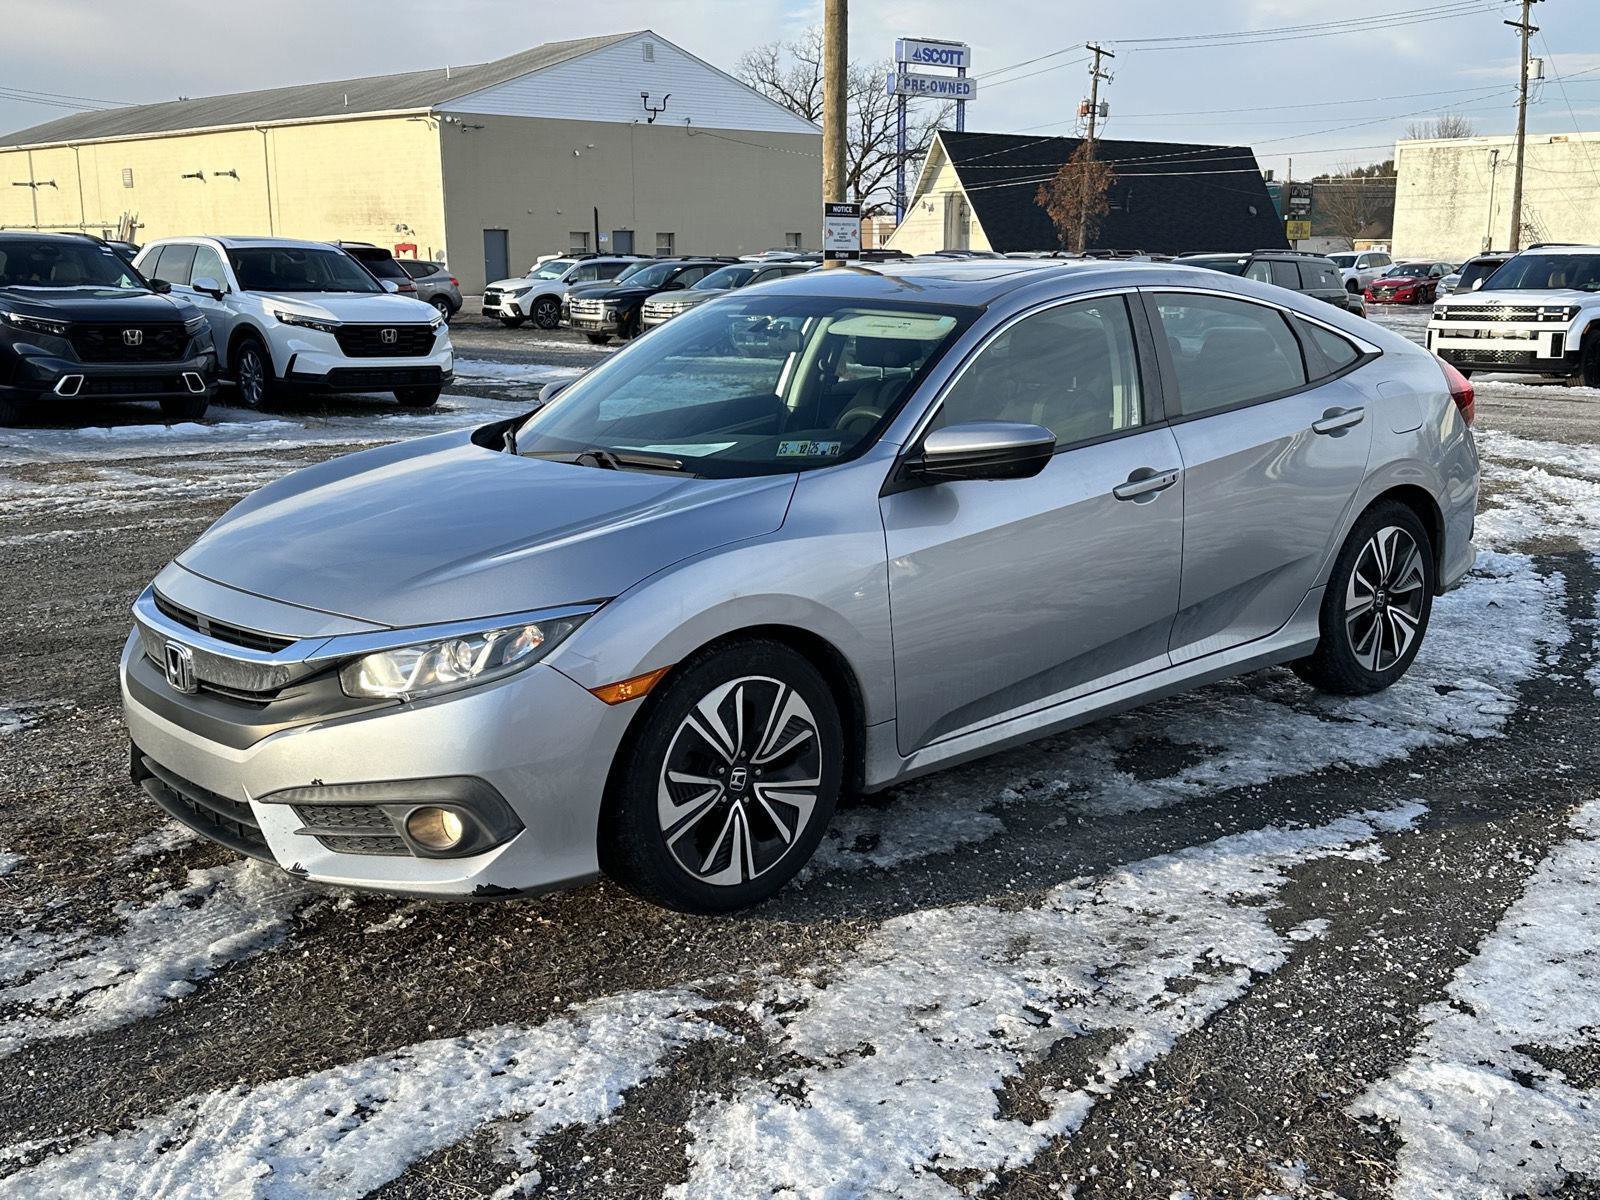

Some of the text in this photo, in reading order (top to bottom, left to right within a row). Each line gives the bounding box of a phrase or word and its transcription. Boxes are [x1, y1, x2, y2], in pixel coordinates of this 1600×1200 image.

[922, 47, 964, 65] SCOTT
[903, 78, 970, 95] PRE-OWNED
[779, 443, 808, 454] 25 12
[810, 443, 839, 455] 25 12
